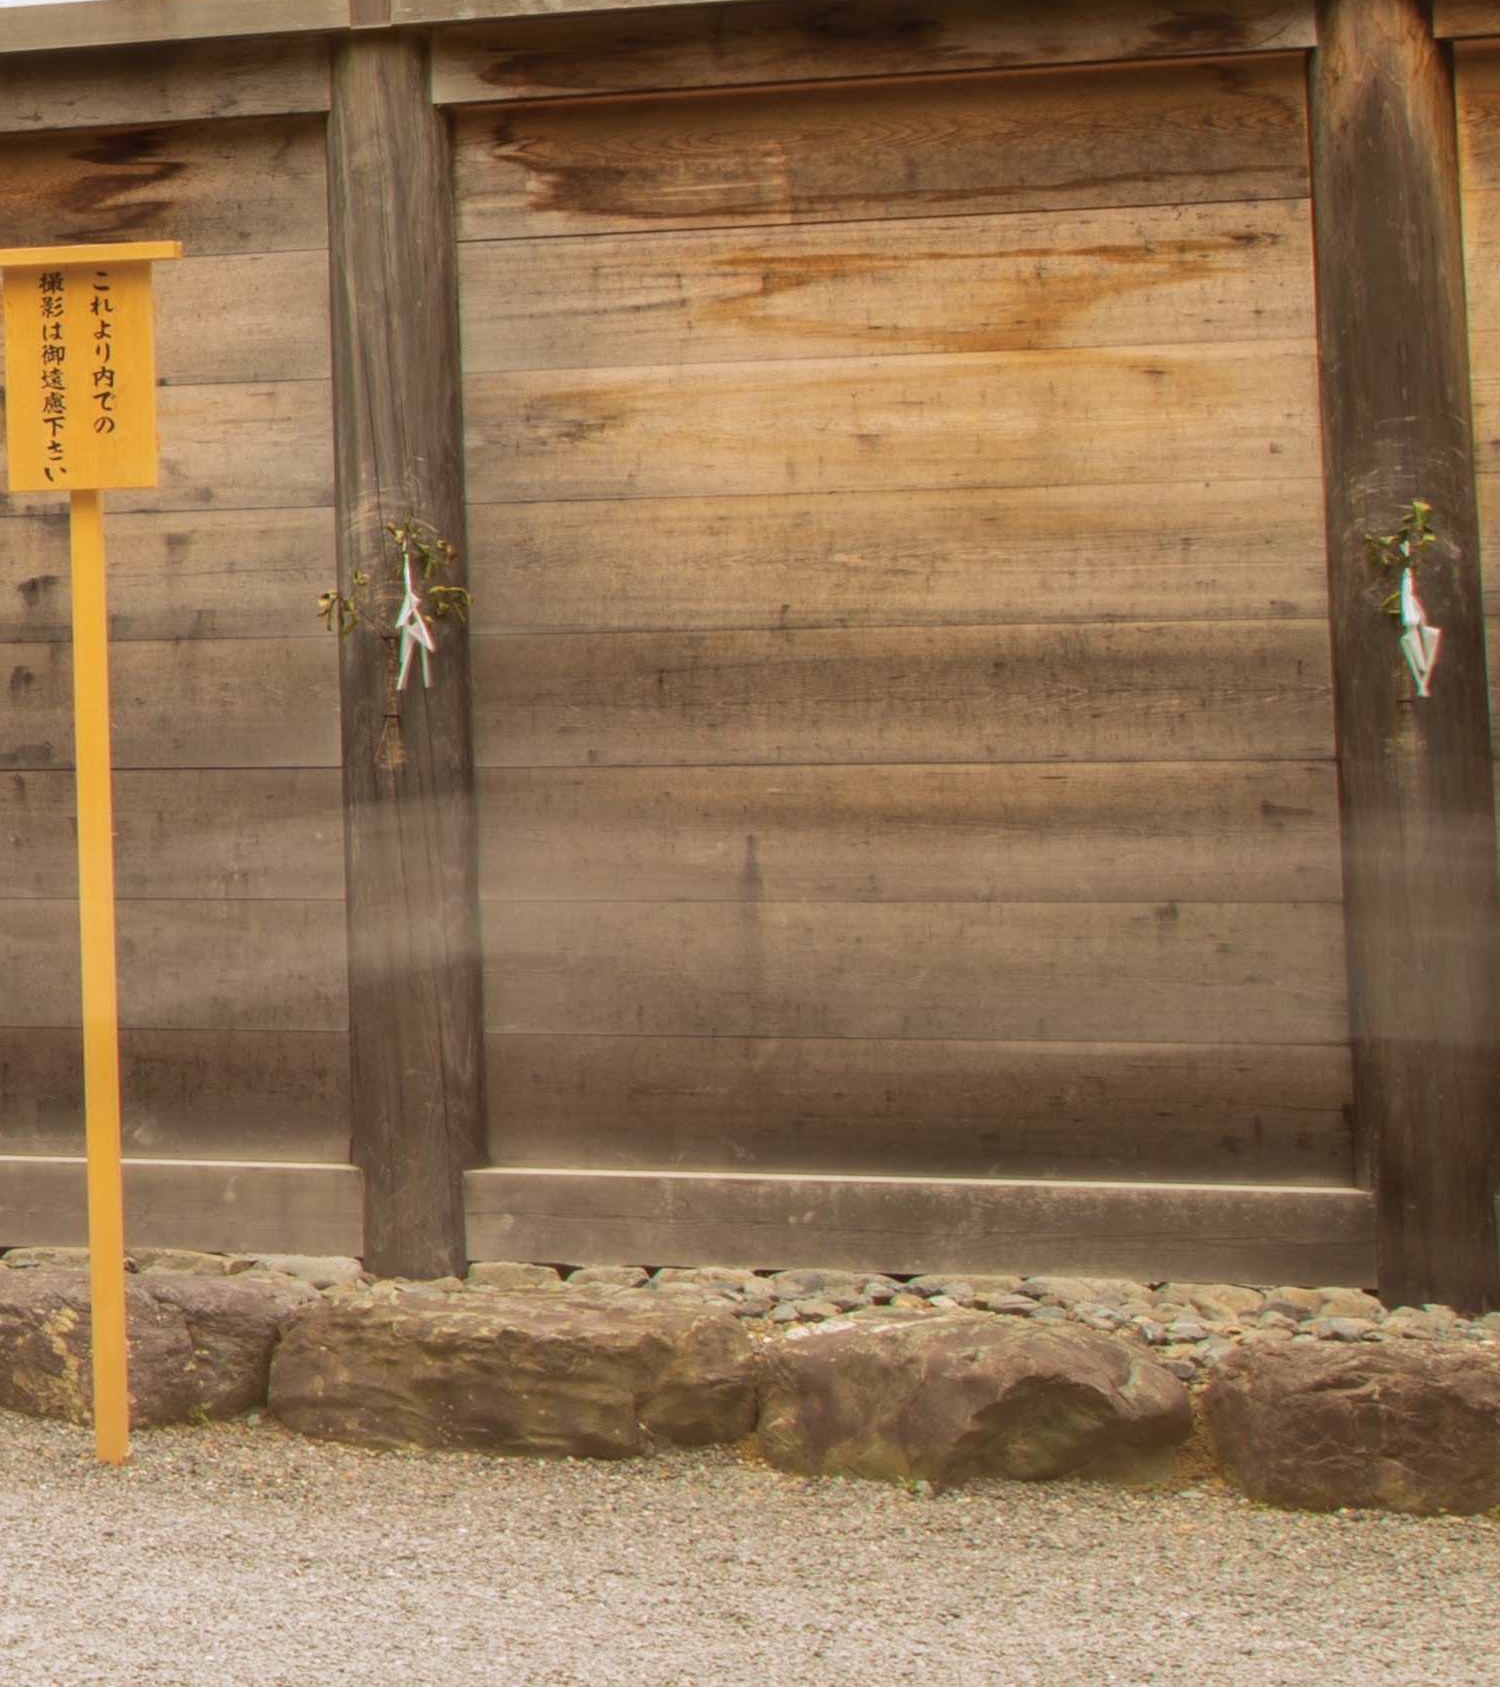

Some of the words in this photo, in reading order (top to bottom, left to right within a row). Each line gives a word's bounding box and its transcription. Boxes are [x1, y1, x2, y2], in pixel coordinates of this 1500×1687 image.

[39, 272, 67, 482] 撮影は御遠慮下さい
[90, 270, 116, 434] これより内での
